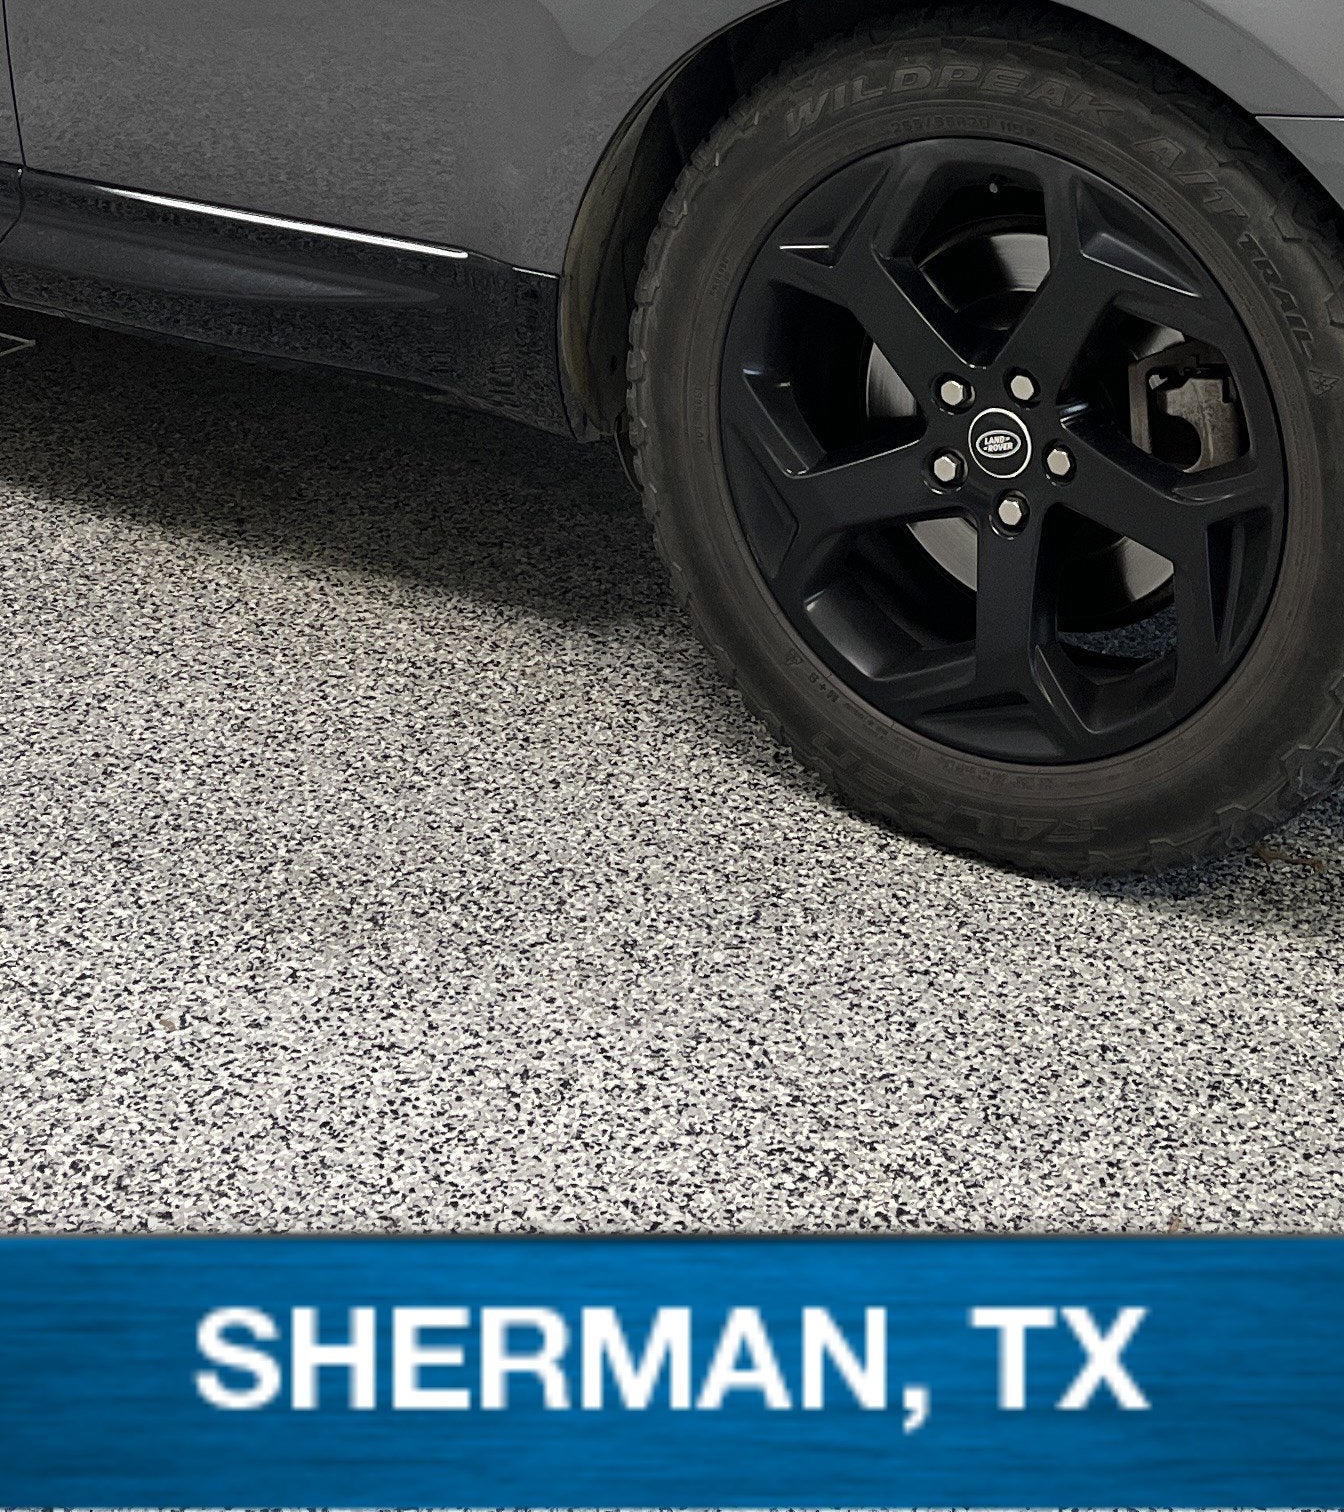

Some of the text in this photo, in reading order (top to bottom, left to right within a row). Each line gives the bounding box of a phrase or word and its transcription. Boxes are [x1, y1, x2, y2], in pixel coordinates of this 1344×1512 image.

[785, 63, 1313, 361] WILDPEAK A/T TRAIL
[984, 435, 1005, 445] LAND
[987, 442, 1014, 452] ROVER
